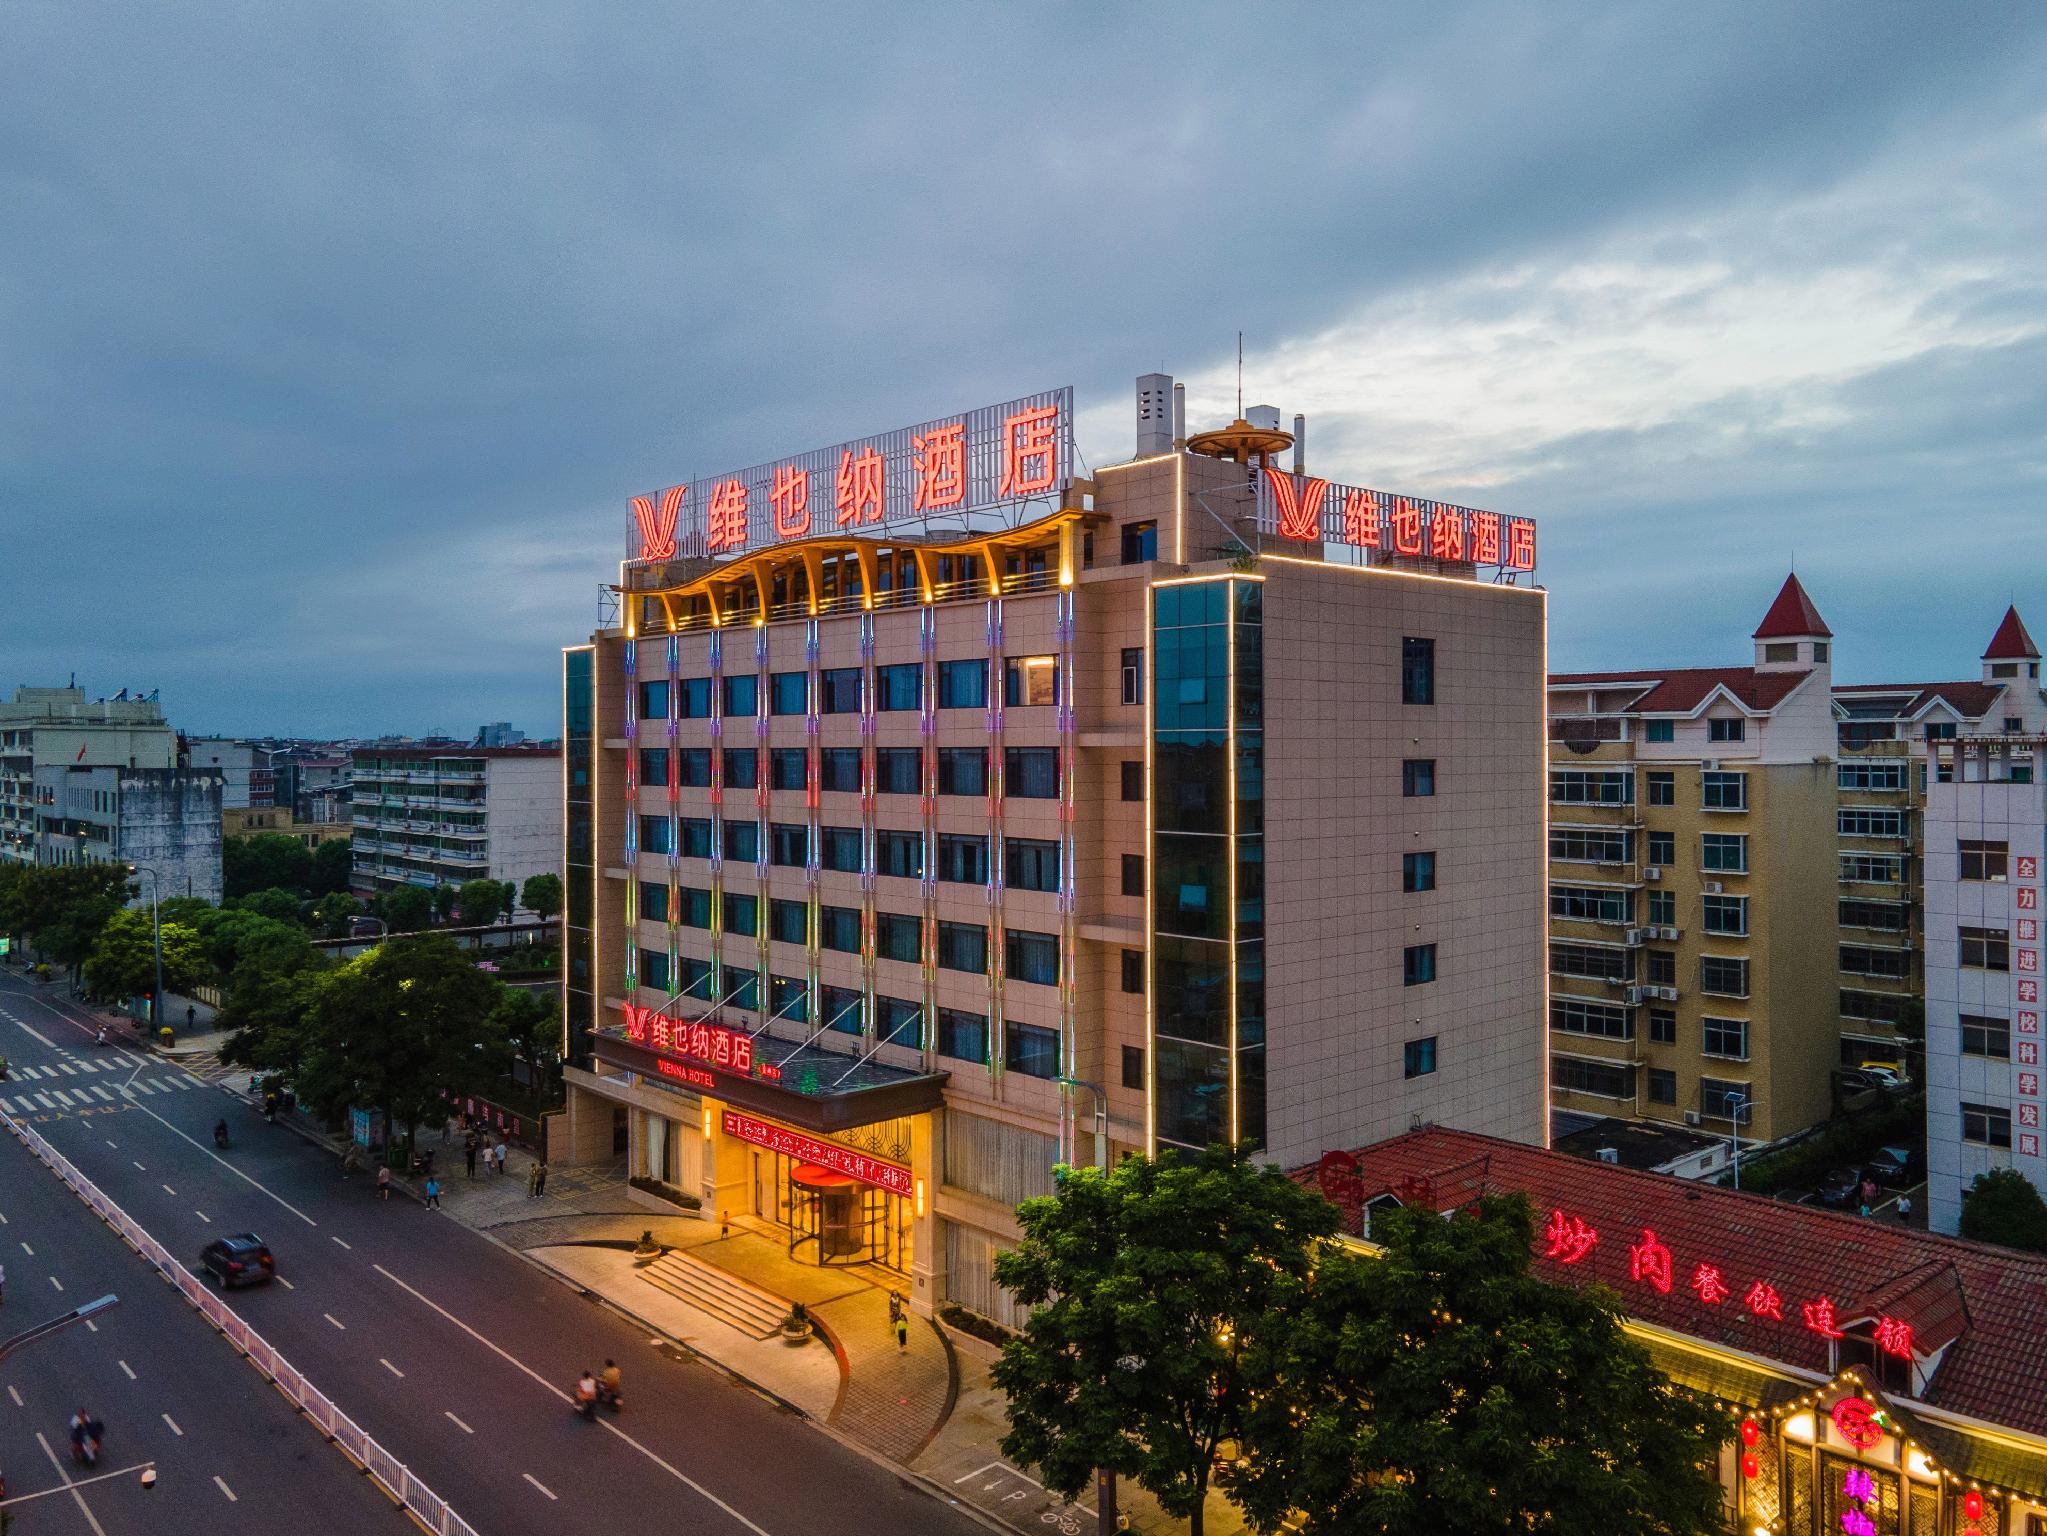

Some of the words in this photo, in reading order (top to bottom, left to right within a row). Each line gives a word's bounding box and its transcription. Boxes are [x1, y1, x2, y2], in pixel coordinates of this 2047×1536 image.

[708, 406, 1057, 549] 维也纳酒店
[1345, 490, 1535, 570] 维也纳酒店
[652, 1014, 751, 1071] 维也纳酒店
[2018, 858, 2038, 1156] 全力推进学校科学发展
[658, 1060, 687, 1079] VIENNA
[688, 1070, 715, 1088] HOTEL
